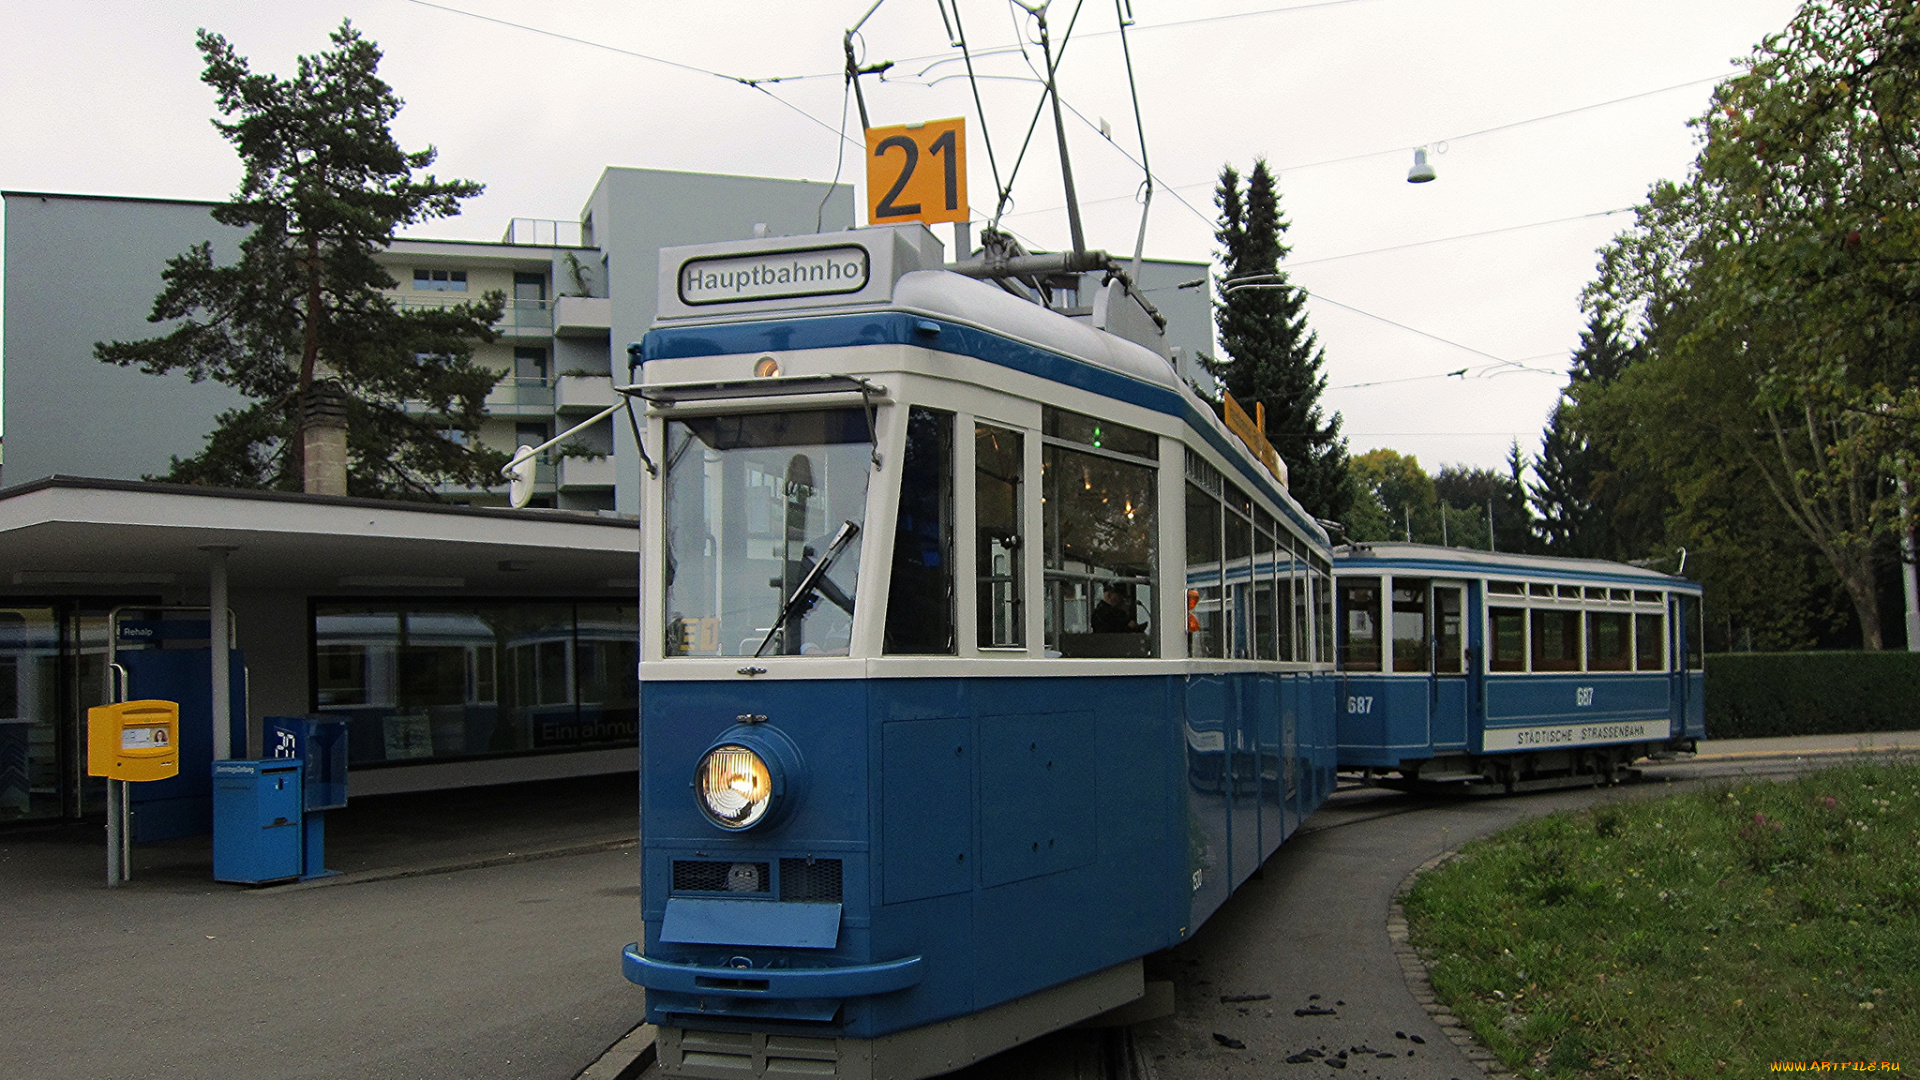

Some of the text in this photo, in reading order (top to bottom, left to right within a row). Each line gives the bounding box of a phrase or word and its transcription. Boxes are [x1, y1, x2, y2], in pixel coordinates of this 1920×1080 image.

[874, 129, 958, 218] 21
[1347, 696, 1374, 714] 687
[1576, 687, 1594, 706] 687
[1581, 725, 1646, 740] STRASSENBAHN
